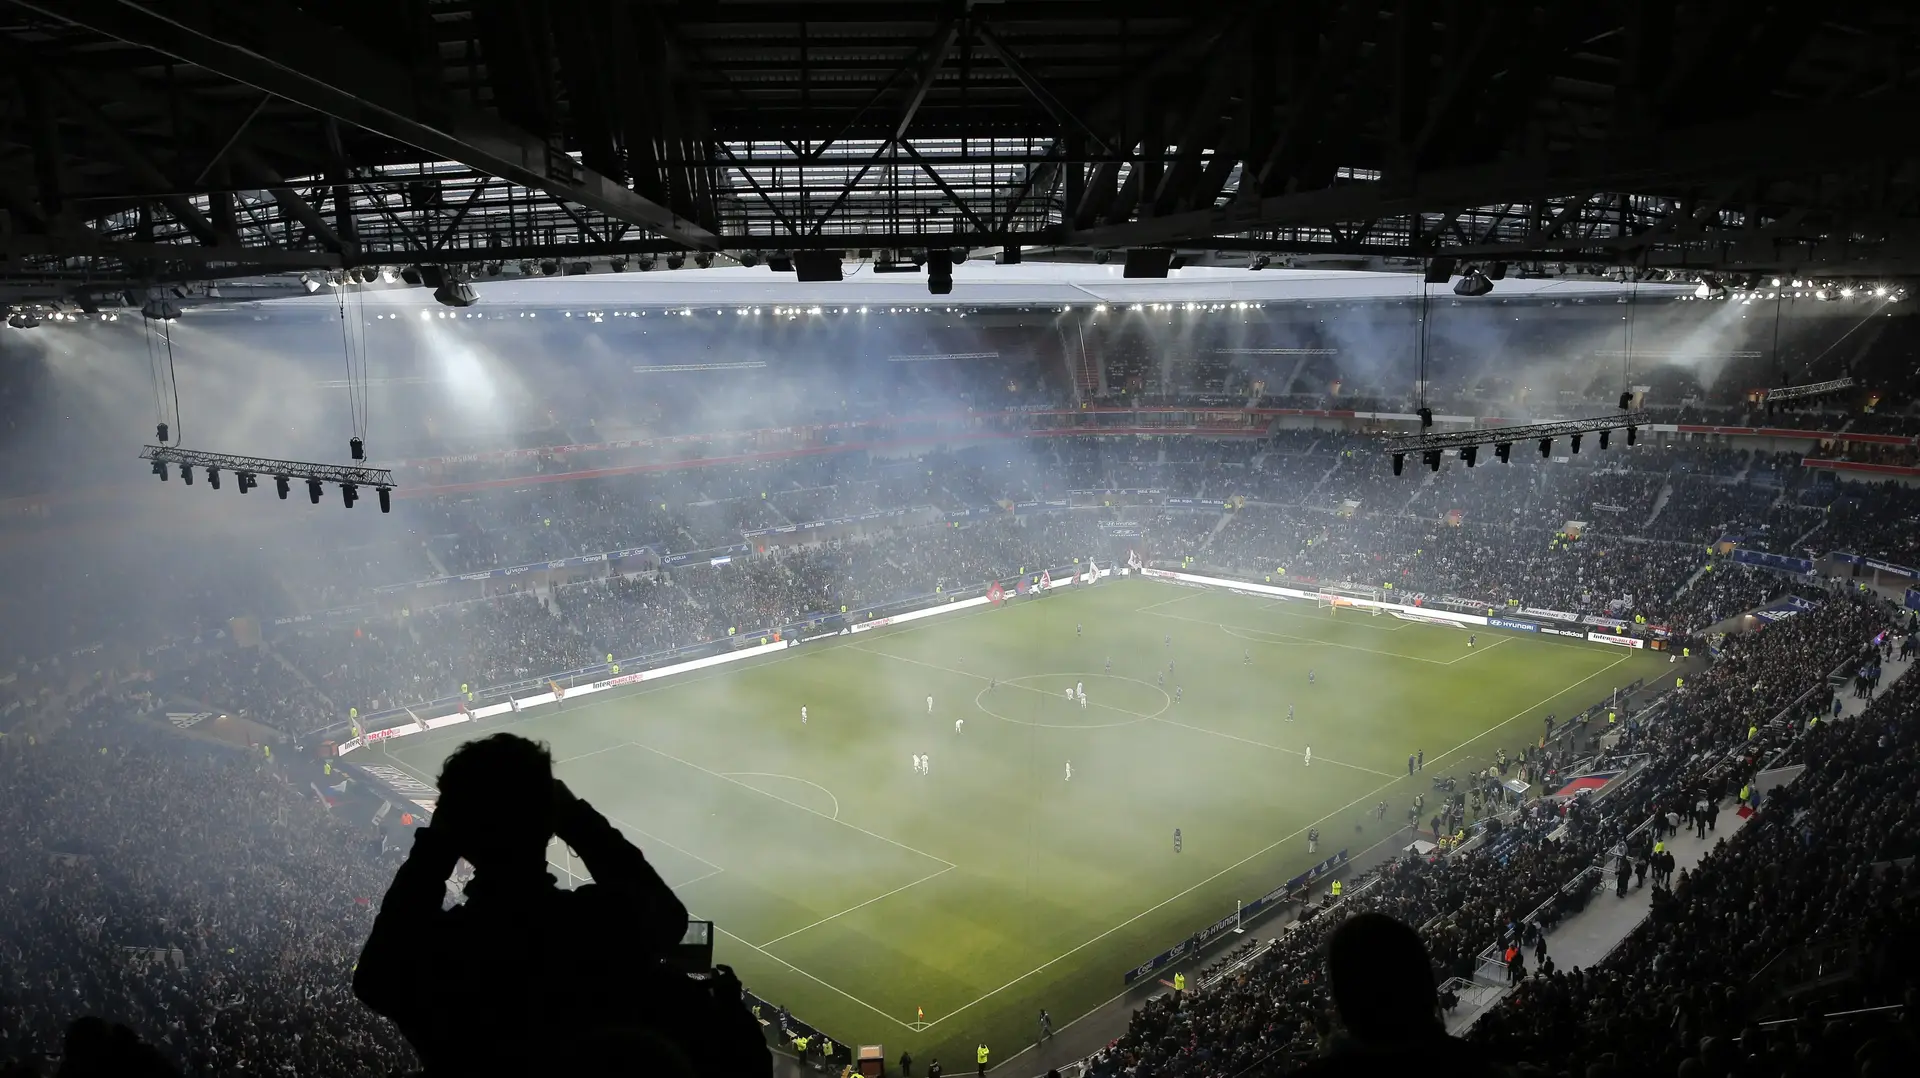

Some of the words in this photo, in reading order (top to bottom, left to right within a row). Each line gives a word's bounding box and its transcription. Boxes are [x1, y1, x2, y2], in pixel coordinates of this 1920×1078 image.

[441, 454, 478, 464] SAMSUNG
[582, 555, 601, 563] Orange
[1503, 621, 1534, 631] HYUNDAI
[1559, 630, 1584, 639] adidas
